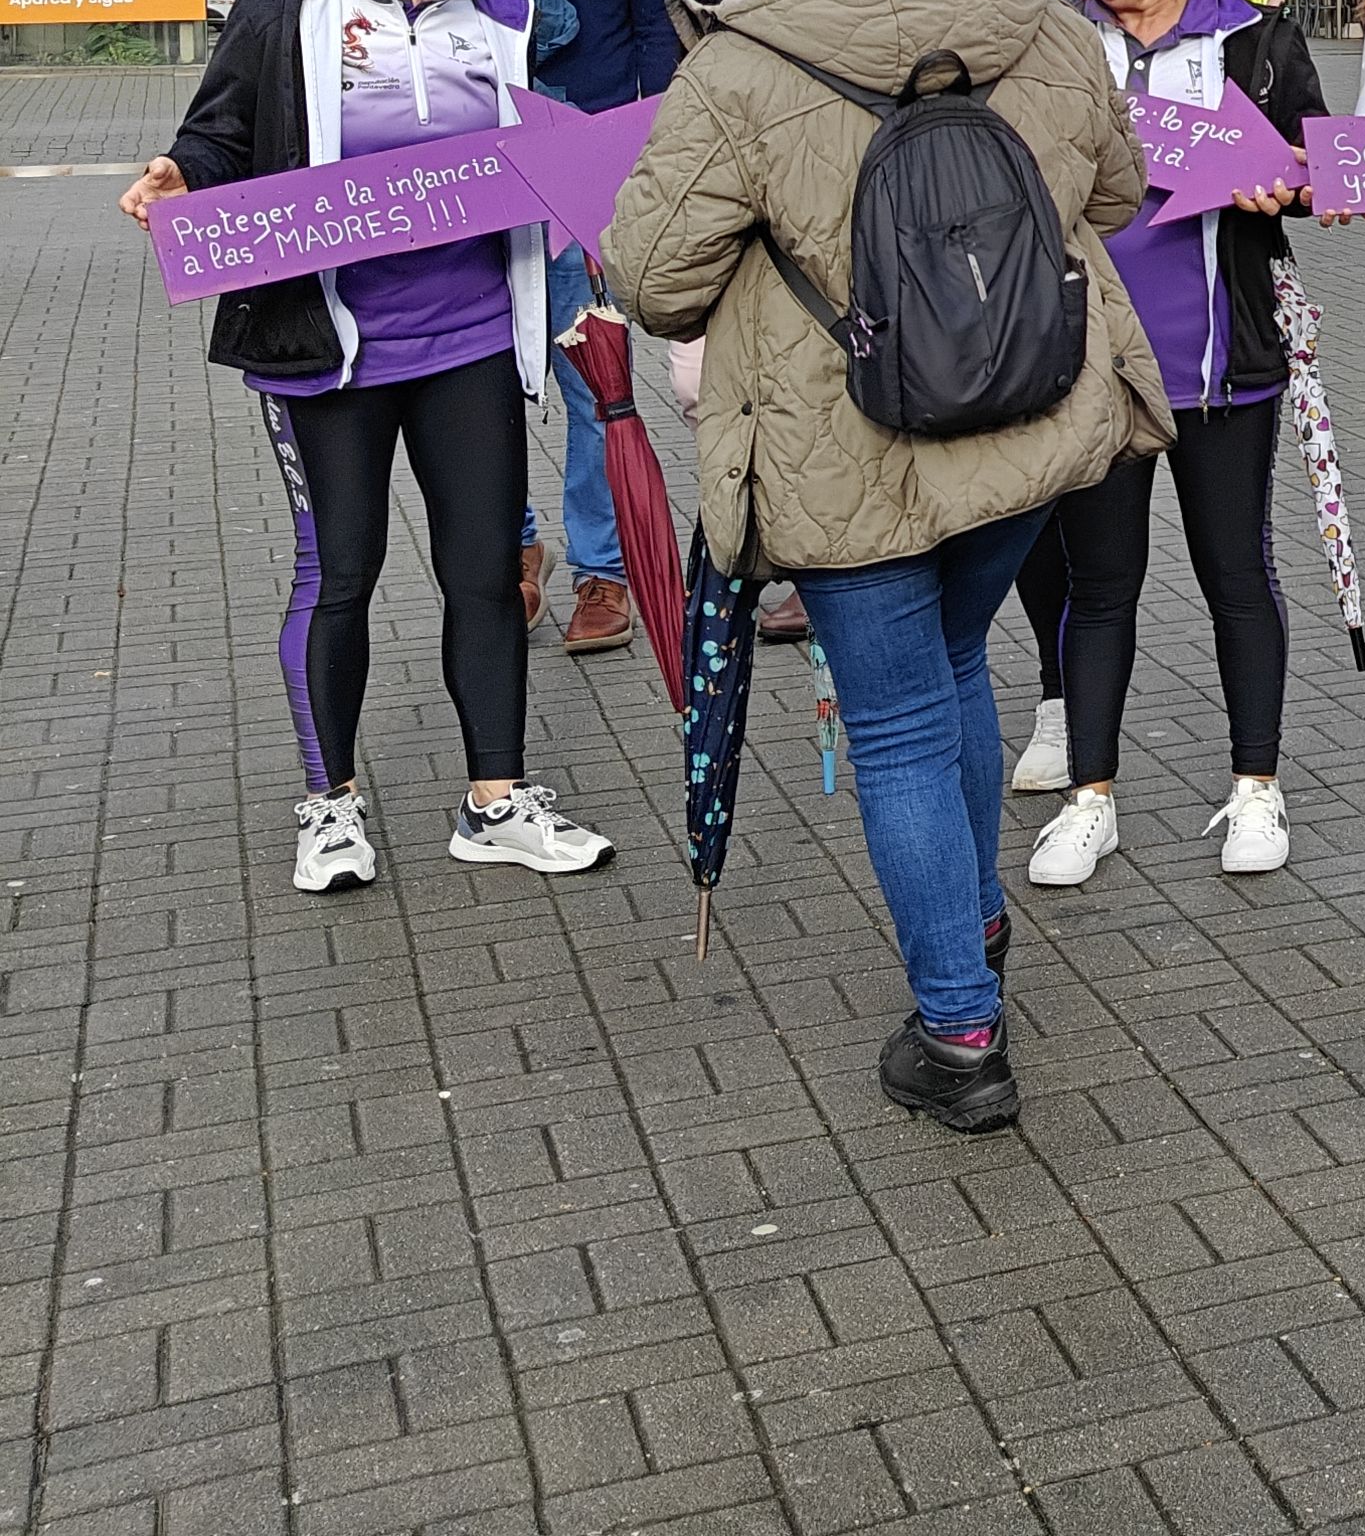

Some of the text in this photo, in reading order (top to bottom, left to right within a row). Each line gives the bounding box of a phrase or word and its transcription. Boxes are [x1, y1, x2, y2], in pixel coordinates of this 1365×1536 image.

[1160, 105, 1183, 131] lo
[1189, 120, 1243, 148] que
[171, 156, 502, 246] Proteger a la infancia
[183, 255, 205, 276] a
[208, 242, 255, 270] las
[274, 205, 412, 258] MADRES
